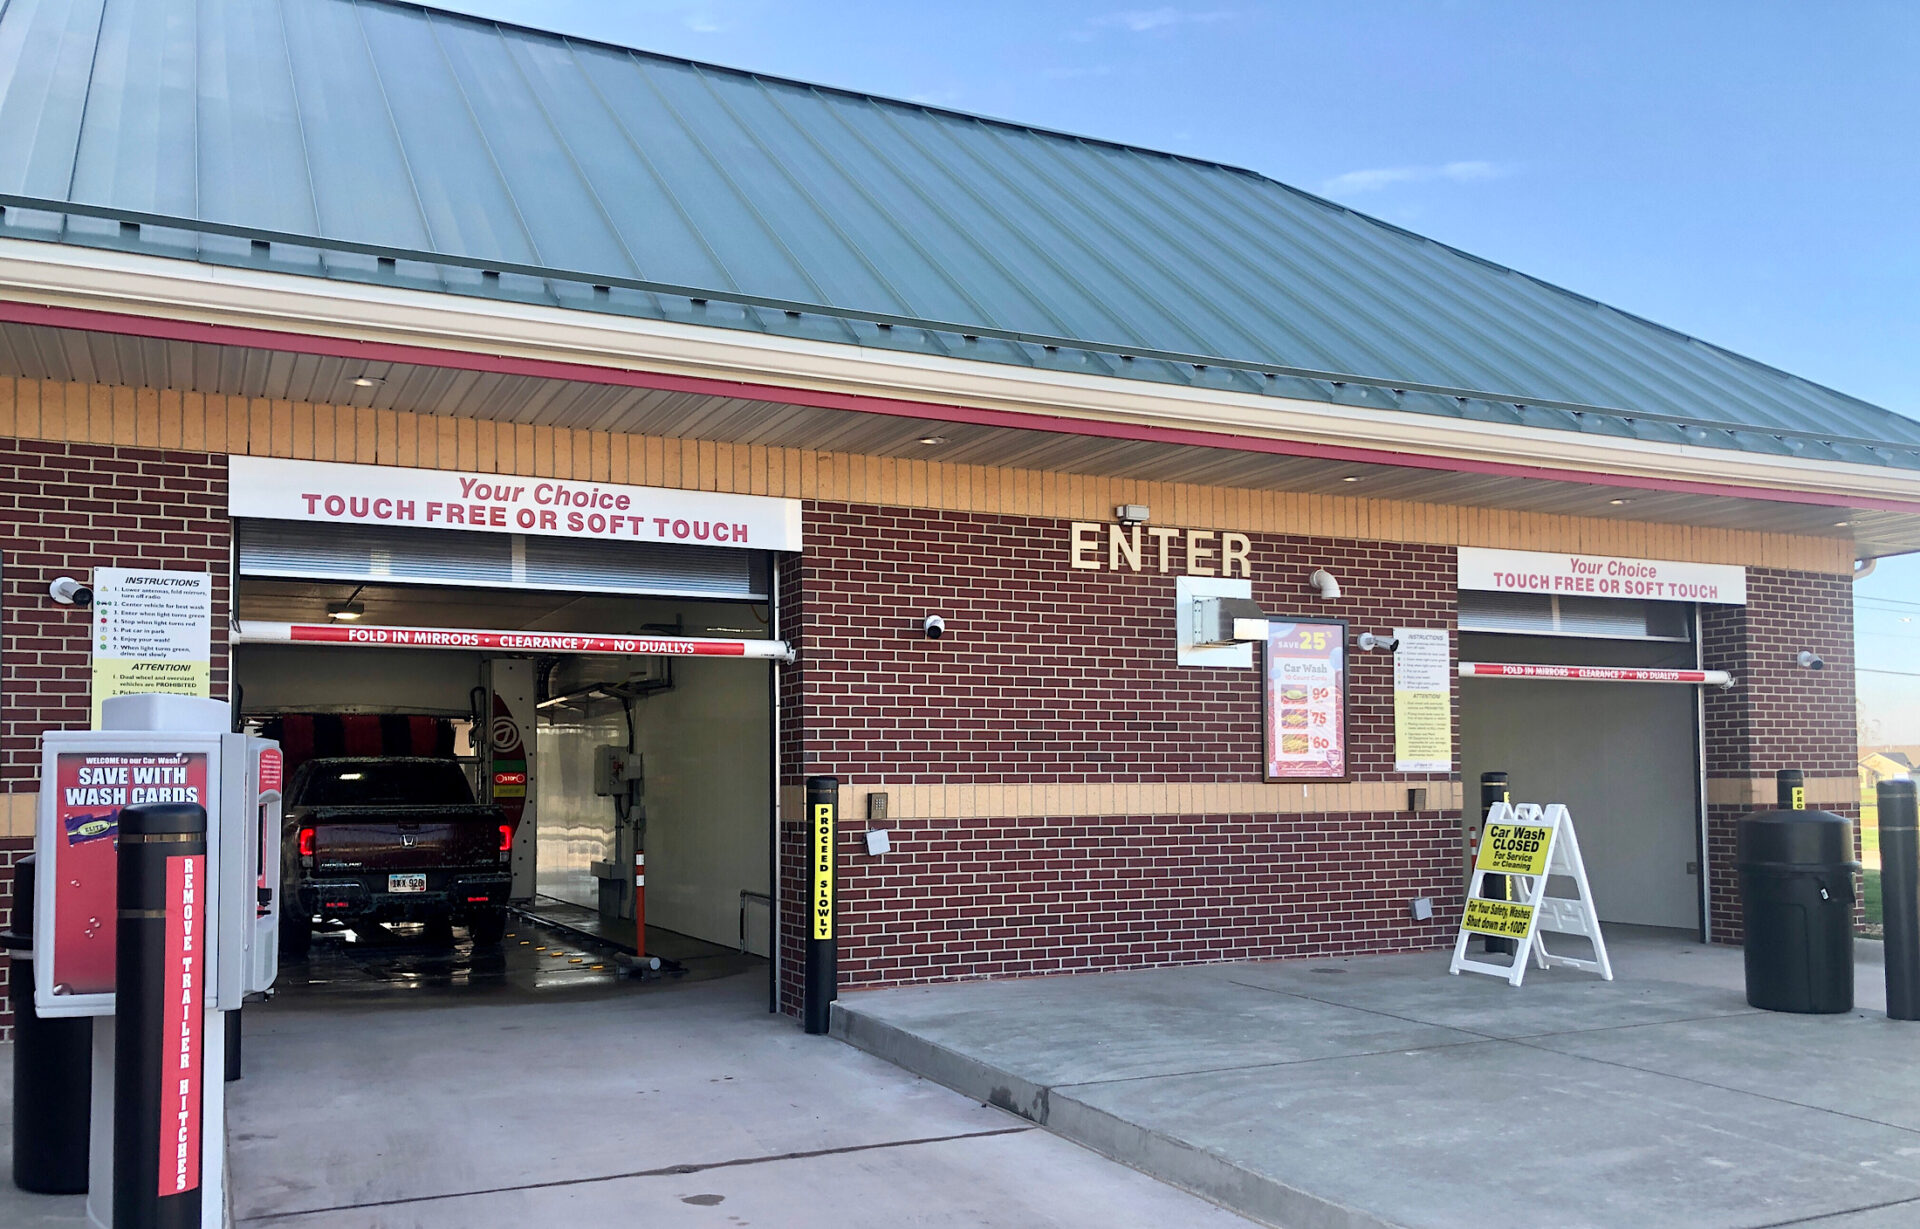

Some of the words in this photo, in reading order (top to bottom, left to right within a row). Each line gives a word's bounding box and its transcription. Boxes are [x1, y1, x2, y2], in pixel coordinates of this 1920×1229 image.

[459, 477, 525, 502] Your
[534, 483, 631, 510] Choice
[301, 493, 415, 521] TOUCH
[426, 502, 507, 527] FREE
[516, 508, 557, 530] OR
[567, 511, 644, 536] SOFT
[652, 518, 748, 543] TOUCH
[1071, 521, 1251, 578] ENTER
[1570, 558, 1603, 574] Your
[1607, 560, 1657, 578] Choice
[125, 576, 200, 587] INSTRUCTIONS
[1493, 572, 1550, 589] TOUCH
[1554, 576, 1595, 592] FREE
[1599, 578, 1620, 593] OR
[1624, 580, 1664, 596] SOFT
[1668, 583, 1718, 599] TOUCH
[348, 629, 388, 642] FOLD
[392, 631, 409, 643] IN
[413, 632, 479, 645] MIRRORS
[499, 636, 578, 649] CLEARANCE
[582, 639, 594, 649] 7'
[613, 640, 636, 651] NO
[639, 641, 695, 654] DUALLYS
[1278, 641, 1299, 649] SAVE
[131, 663, 191, 672] ATTENTION!
[1284, 663, 1302, 673] Car
[1302, 663, 1328, 674] Wash
[1503, 666, 1523, 674] FOLD
[1524, 666, 1534, 675] IN
[1536, 667, 1569, 676] MIRRORS
[1578, 669, 1619, 678] CLEARANCE
[1636, 671, 1648, 679] NO
[1649, 671, 1679, 680] DUALLYS
[78, 766, 129, 785] SAVE
[133, 766, 187, 785] WITH
[65, 787, 126, 806] WASH
[131, 787, 198, 804] CARDS
[819, 807, 829, 872] PROCEED
[1491, 825, 1511, 838] Car
[1514, 827, 1546, 841] Wash
[1493, 839, 1540, 852] CLOSED
[1494, 851, 1506, 860] For
[1507, 852, 1533, 862] Service
[1501, 860, 1531, 871] Cleaning
[183, 858, 194, 951] REMOVE
[817, 880, 830, 936] SLOWLY
[1468, 901, 1478, 912] For
[1478, 902, 1490, 914] Your
[1509, 906, 1531, 920] Washes
[1466, 914, 1481, 928] Shut
[1481, 917, 1499, 930] down
[1499, 920, 1507, 931] at
[180, 957, 192, 1069] TRAILER
[176, 1079, 190, 1190] HITCHES
